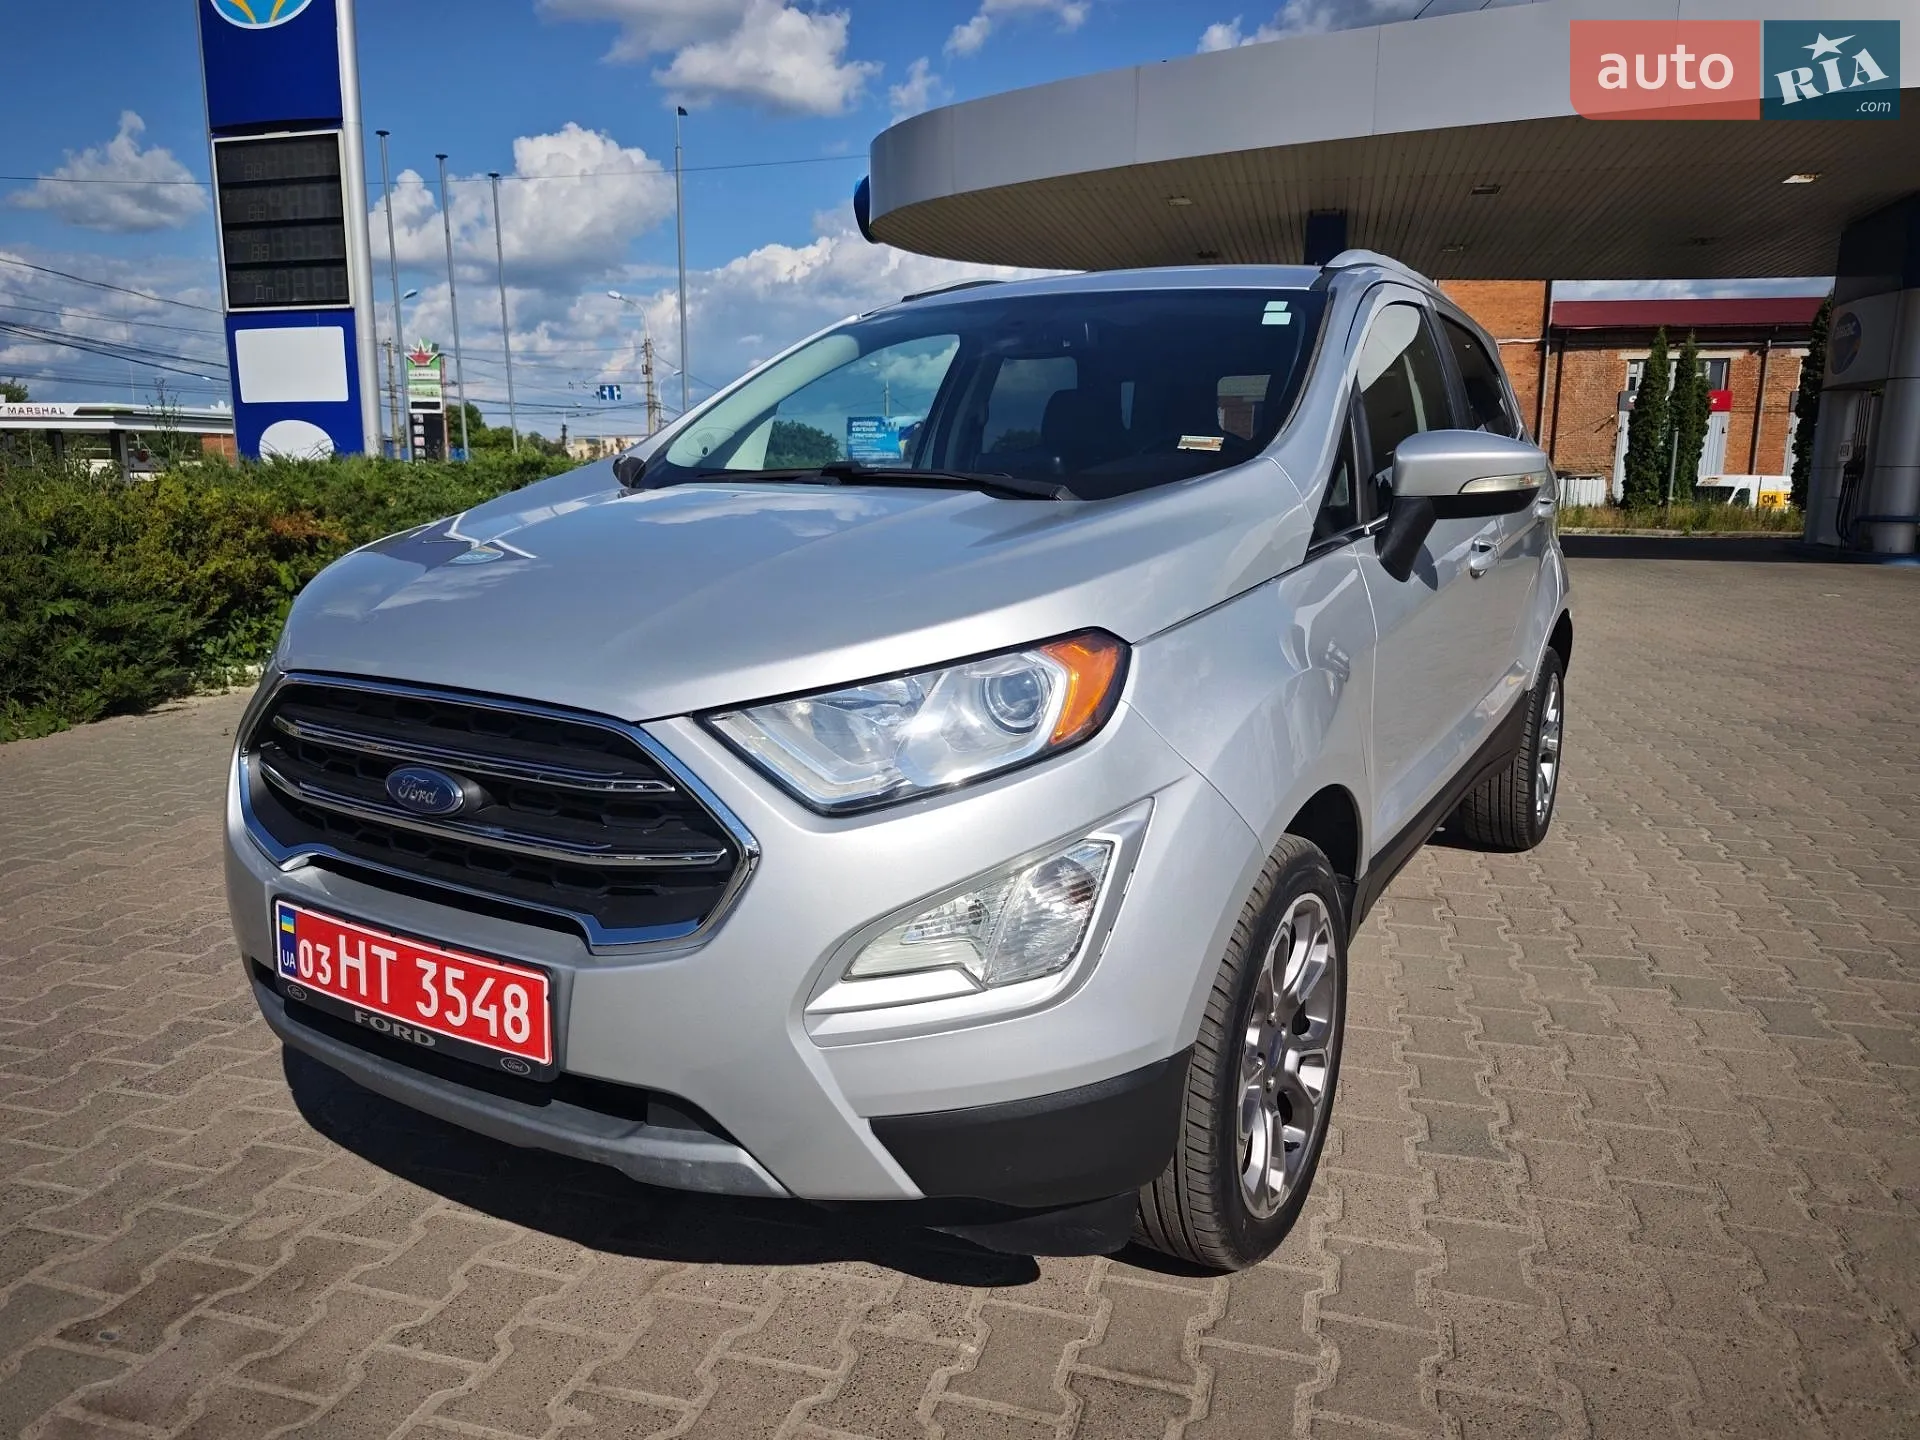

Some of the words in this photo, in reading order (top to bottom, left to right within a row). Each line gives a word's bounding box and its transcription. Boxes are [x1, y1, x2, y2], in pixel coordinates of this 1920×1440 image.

[7, 406, 65, 415] MARSHAL
[397, 774, 439, 805] Ford
[282, 949, 296, 970] UA
[415, 958, 531, 1044] 3548
[354, 1011, 436, 1046] FORD
